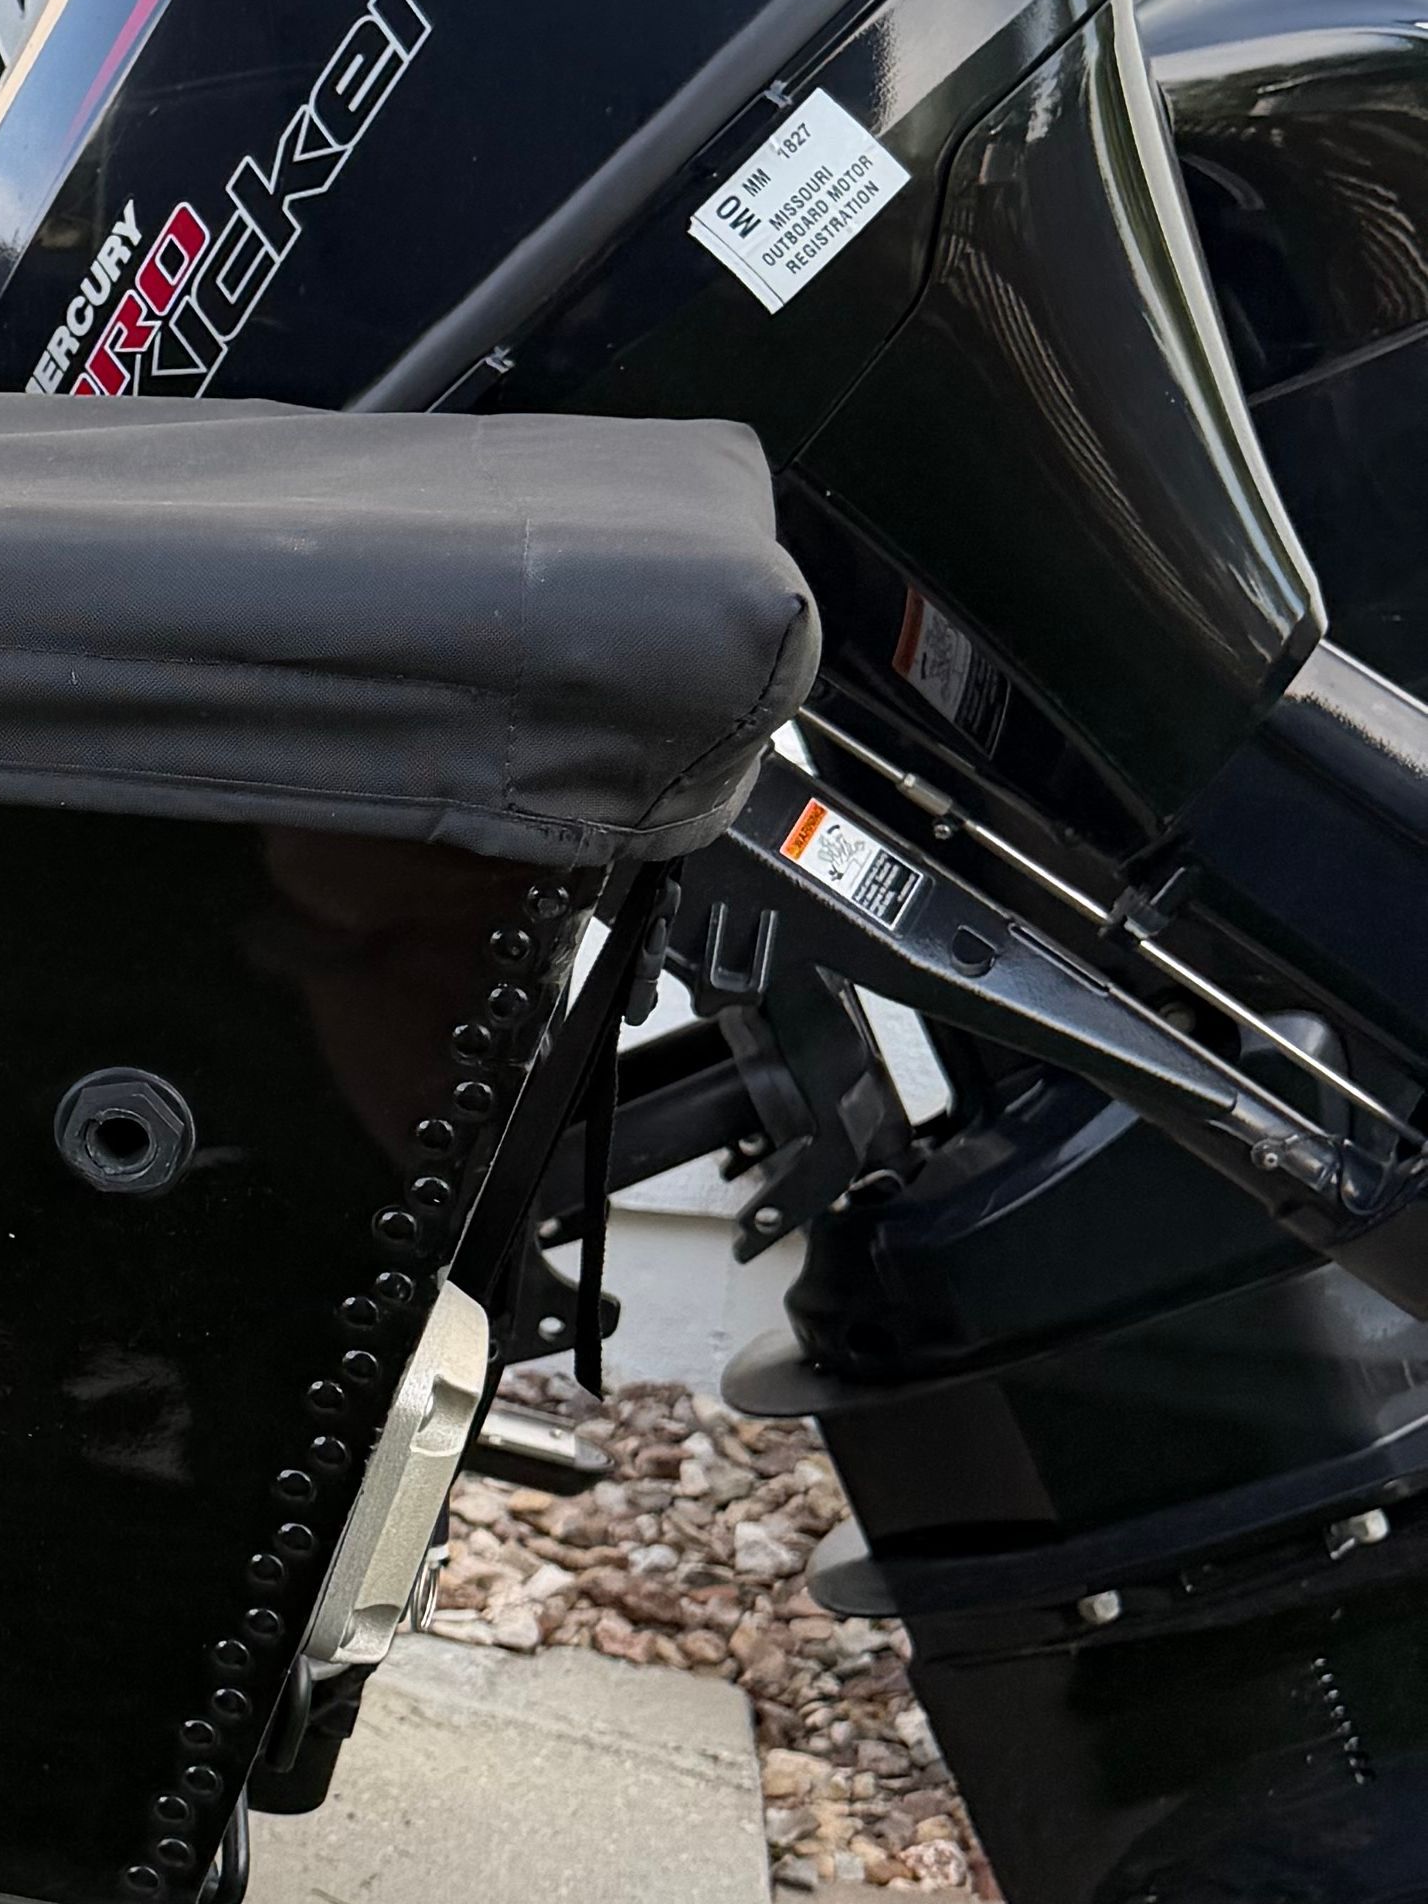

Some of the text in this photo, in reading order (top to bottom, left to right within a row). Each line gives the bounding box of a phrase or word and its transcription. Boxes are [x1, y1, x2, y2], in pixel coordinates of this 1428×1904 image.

[741, 122, 812, 197] MM 1827
[768, 165, 834, 232] MISSOURI
[761, 154, 874, 267] OUTBOARD MOTOR
[785, 179, 881, 275] REGISTRATION
[69, 202, 211, 396] RO
